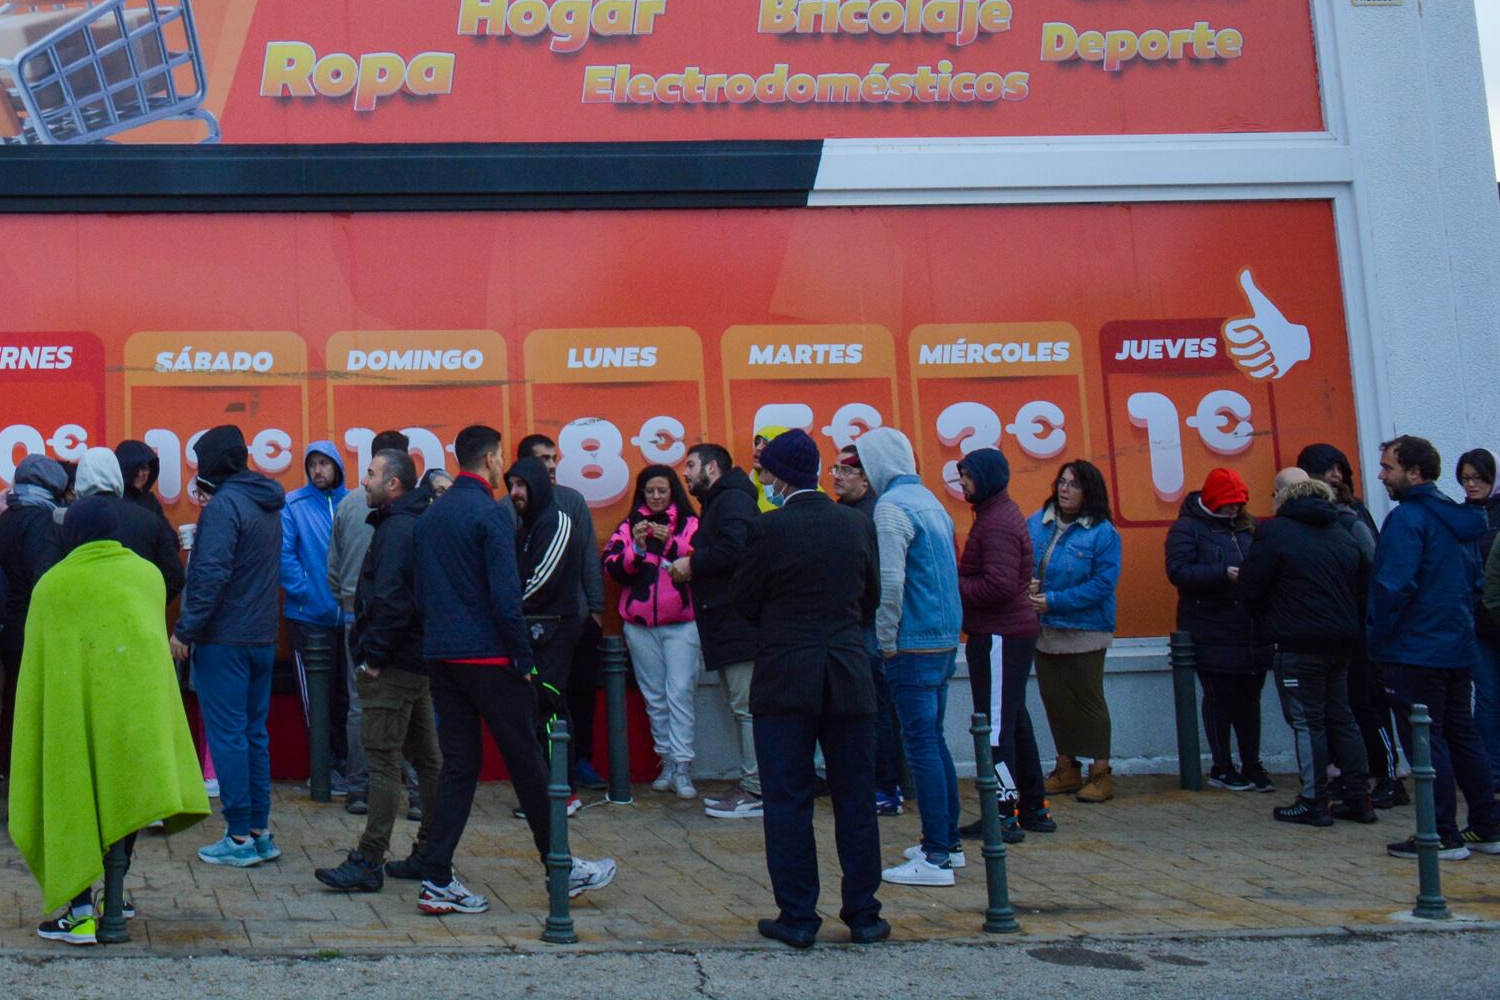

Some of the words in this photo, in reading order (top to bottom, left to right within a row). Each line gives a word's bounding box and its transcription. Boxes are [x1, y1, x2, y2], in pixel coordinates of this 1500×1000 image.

[1040, 22, 1244, 71] Deporte
[260, 41, 455, 112] Ropa
[582, 60, 1029, 103] Electrodomésticos
[155, 345, 274, 373] SÁBADO
[346, 348, 484, 371] DOMINGO
[567, 346, 658, 369] LUNES
[748, 343, 863, 366] MARTES
[919, 338, 1070, 365] MIÉRCOLES
[1115, 336, 1217, 361] JUEVES
[1127, 389, 1254, 501] 1€
[555, 415, 686, 506] 8€
